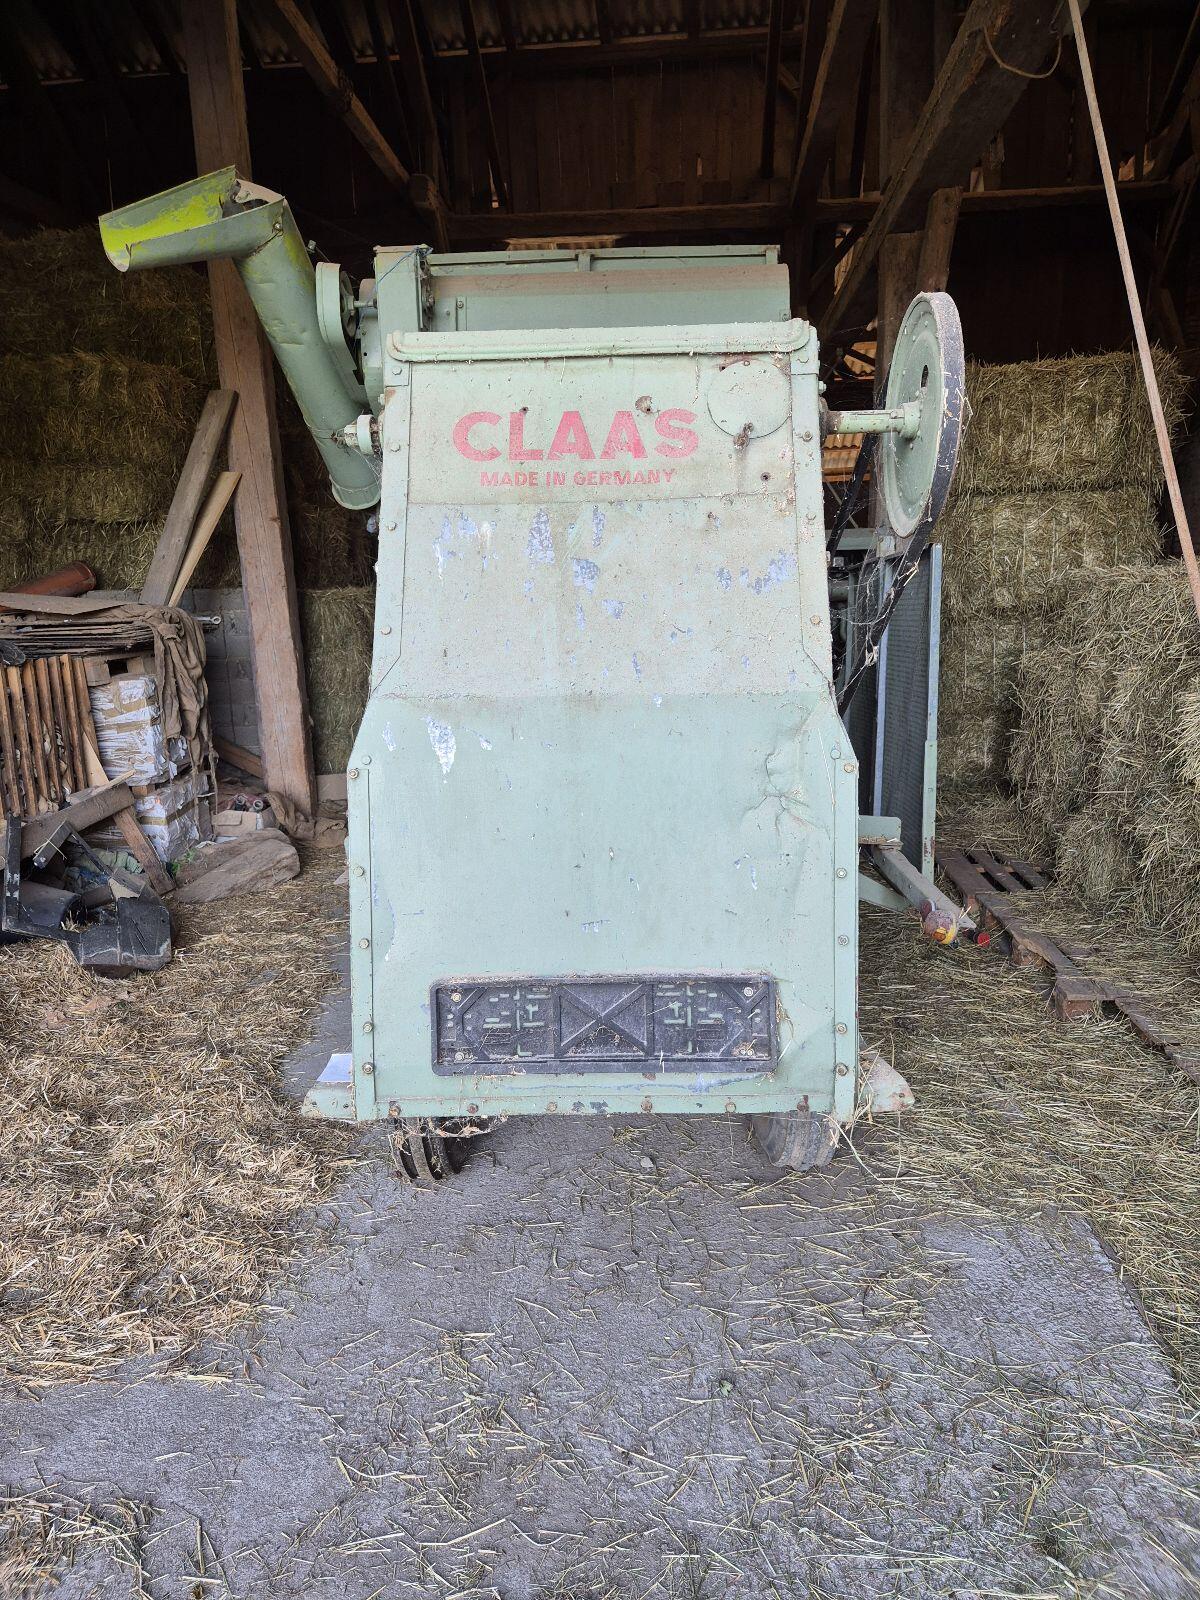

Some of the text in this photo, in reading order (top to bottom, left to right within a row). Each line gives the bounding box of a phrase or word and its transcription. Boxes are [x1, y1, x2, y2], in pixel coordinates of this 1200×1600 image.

[453, 408, 699, 461] CLAAS
[480, 468, 676, 487] MADE IN GERMANY
